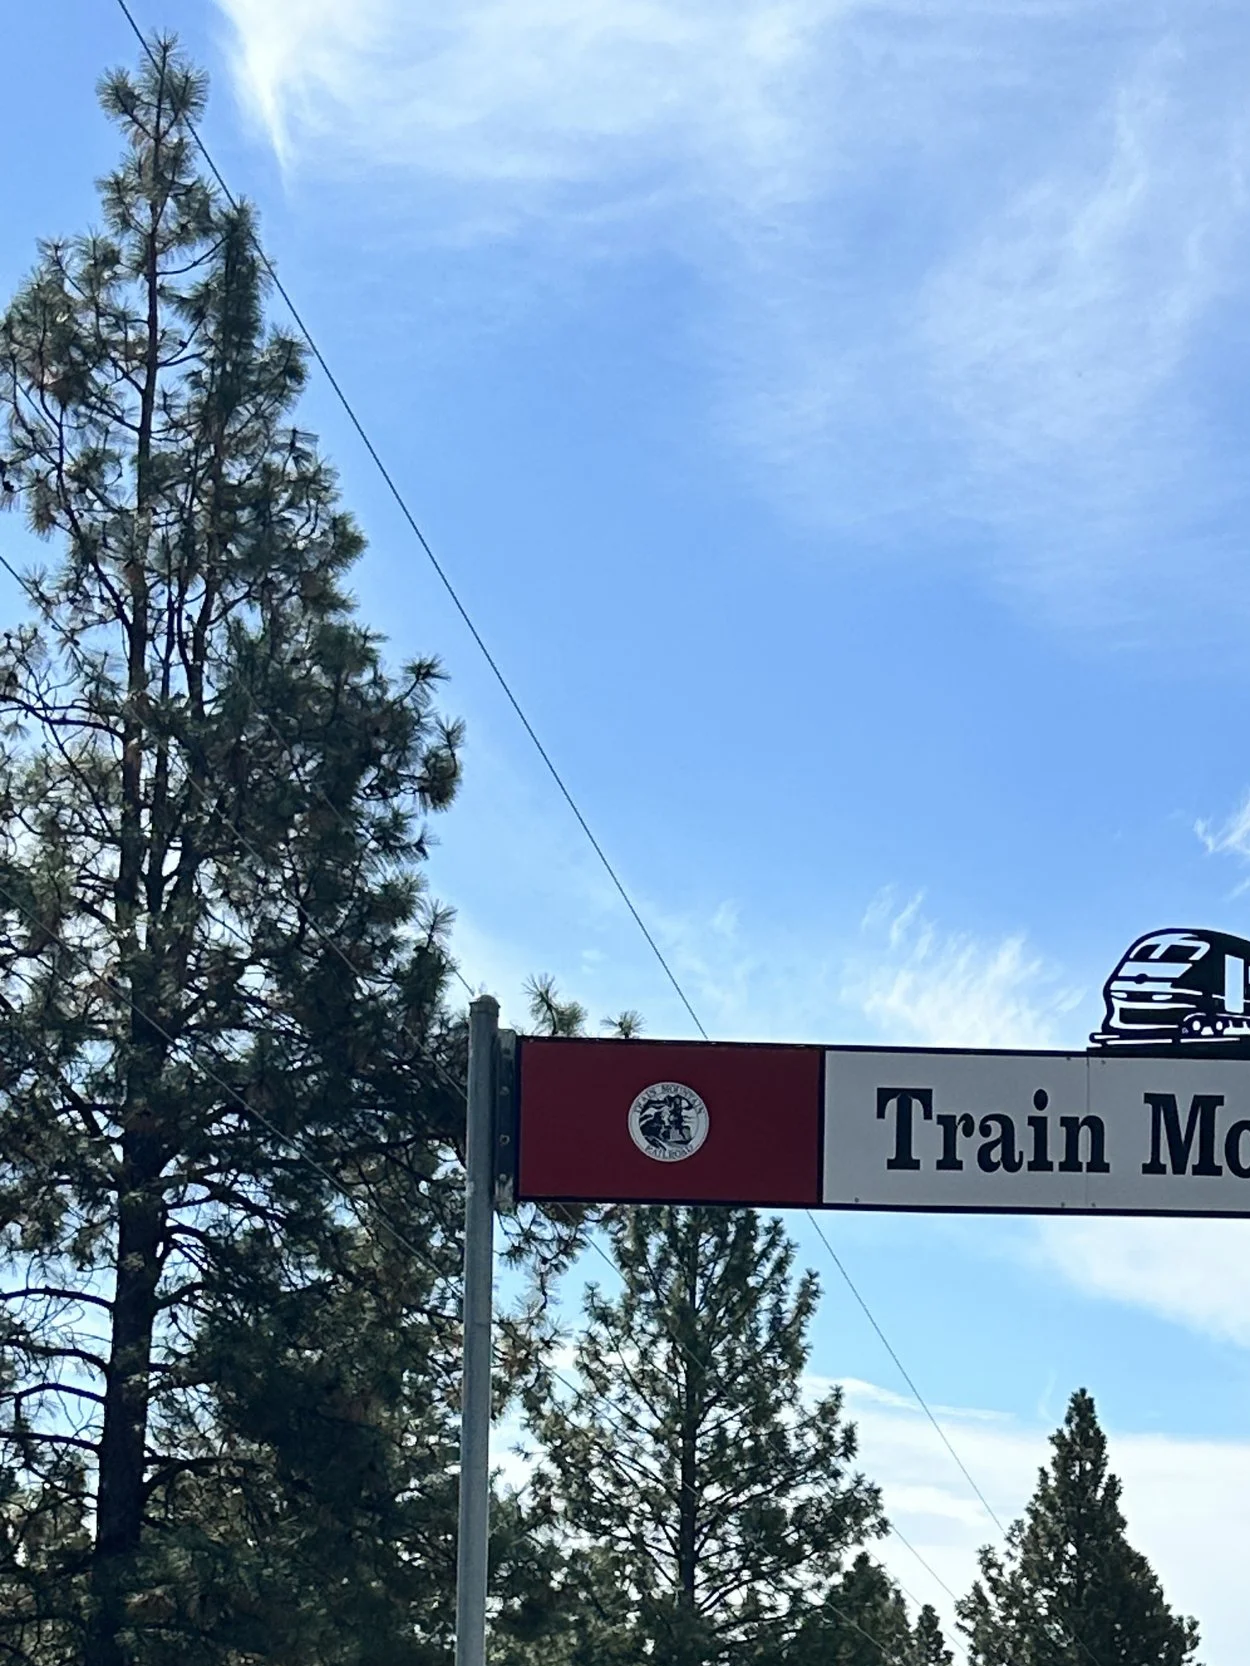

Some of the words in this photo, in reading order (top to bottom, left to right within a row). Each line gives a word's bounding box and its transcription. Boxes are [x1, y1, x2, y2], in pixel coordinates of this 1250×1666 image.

[661, 1084, 705, 1114] MOUNTAIN
[876, 1087, 1111, 1174] Train
[644, 1144, 694, 1160] RAILROAD
